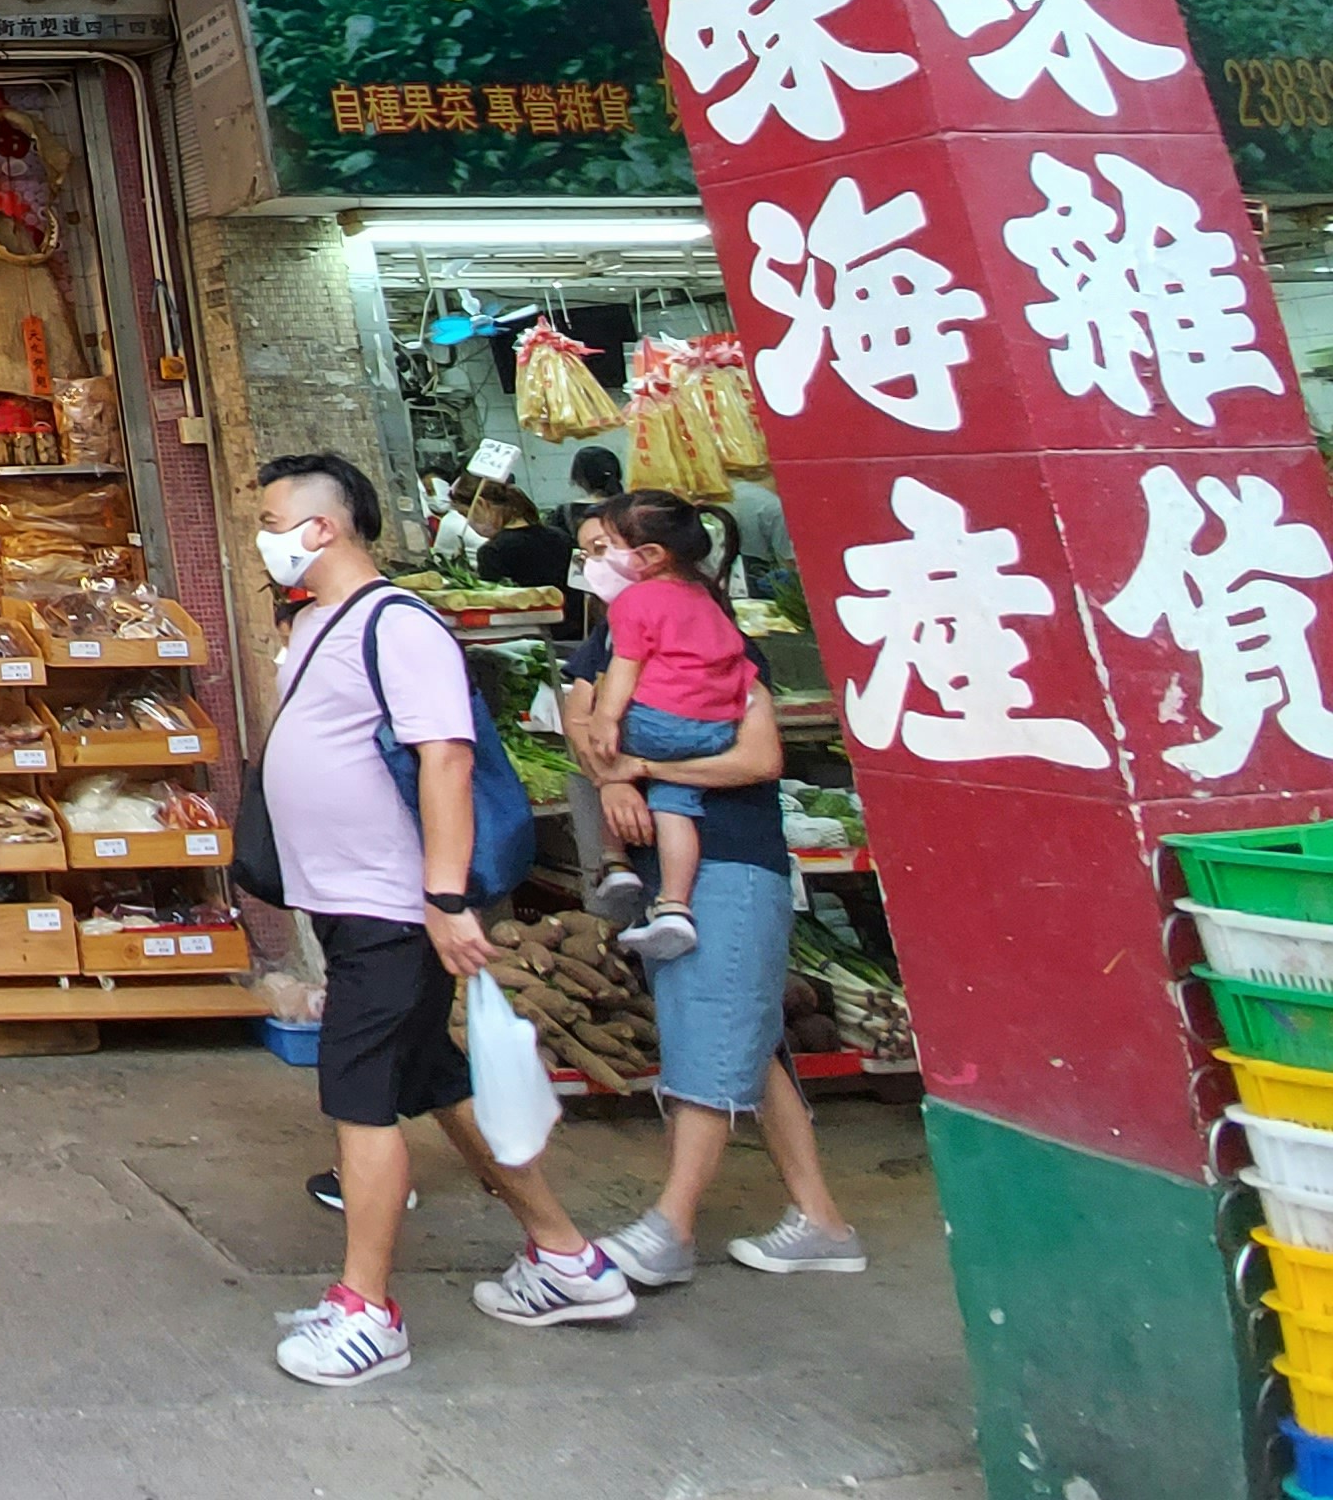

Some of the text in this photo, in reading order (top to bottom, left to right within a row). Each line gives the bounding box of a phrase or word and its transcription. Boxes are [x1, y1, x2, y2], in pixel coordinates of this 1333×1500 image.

[331, 83, 481, 134] 自種果菜
[483, 83, 634, 135] 專營雜貨
